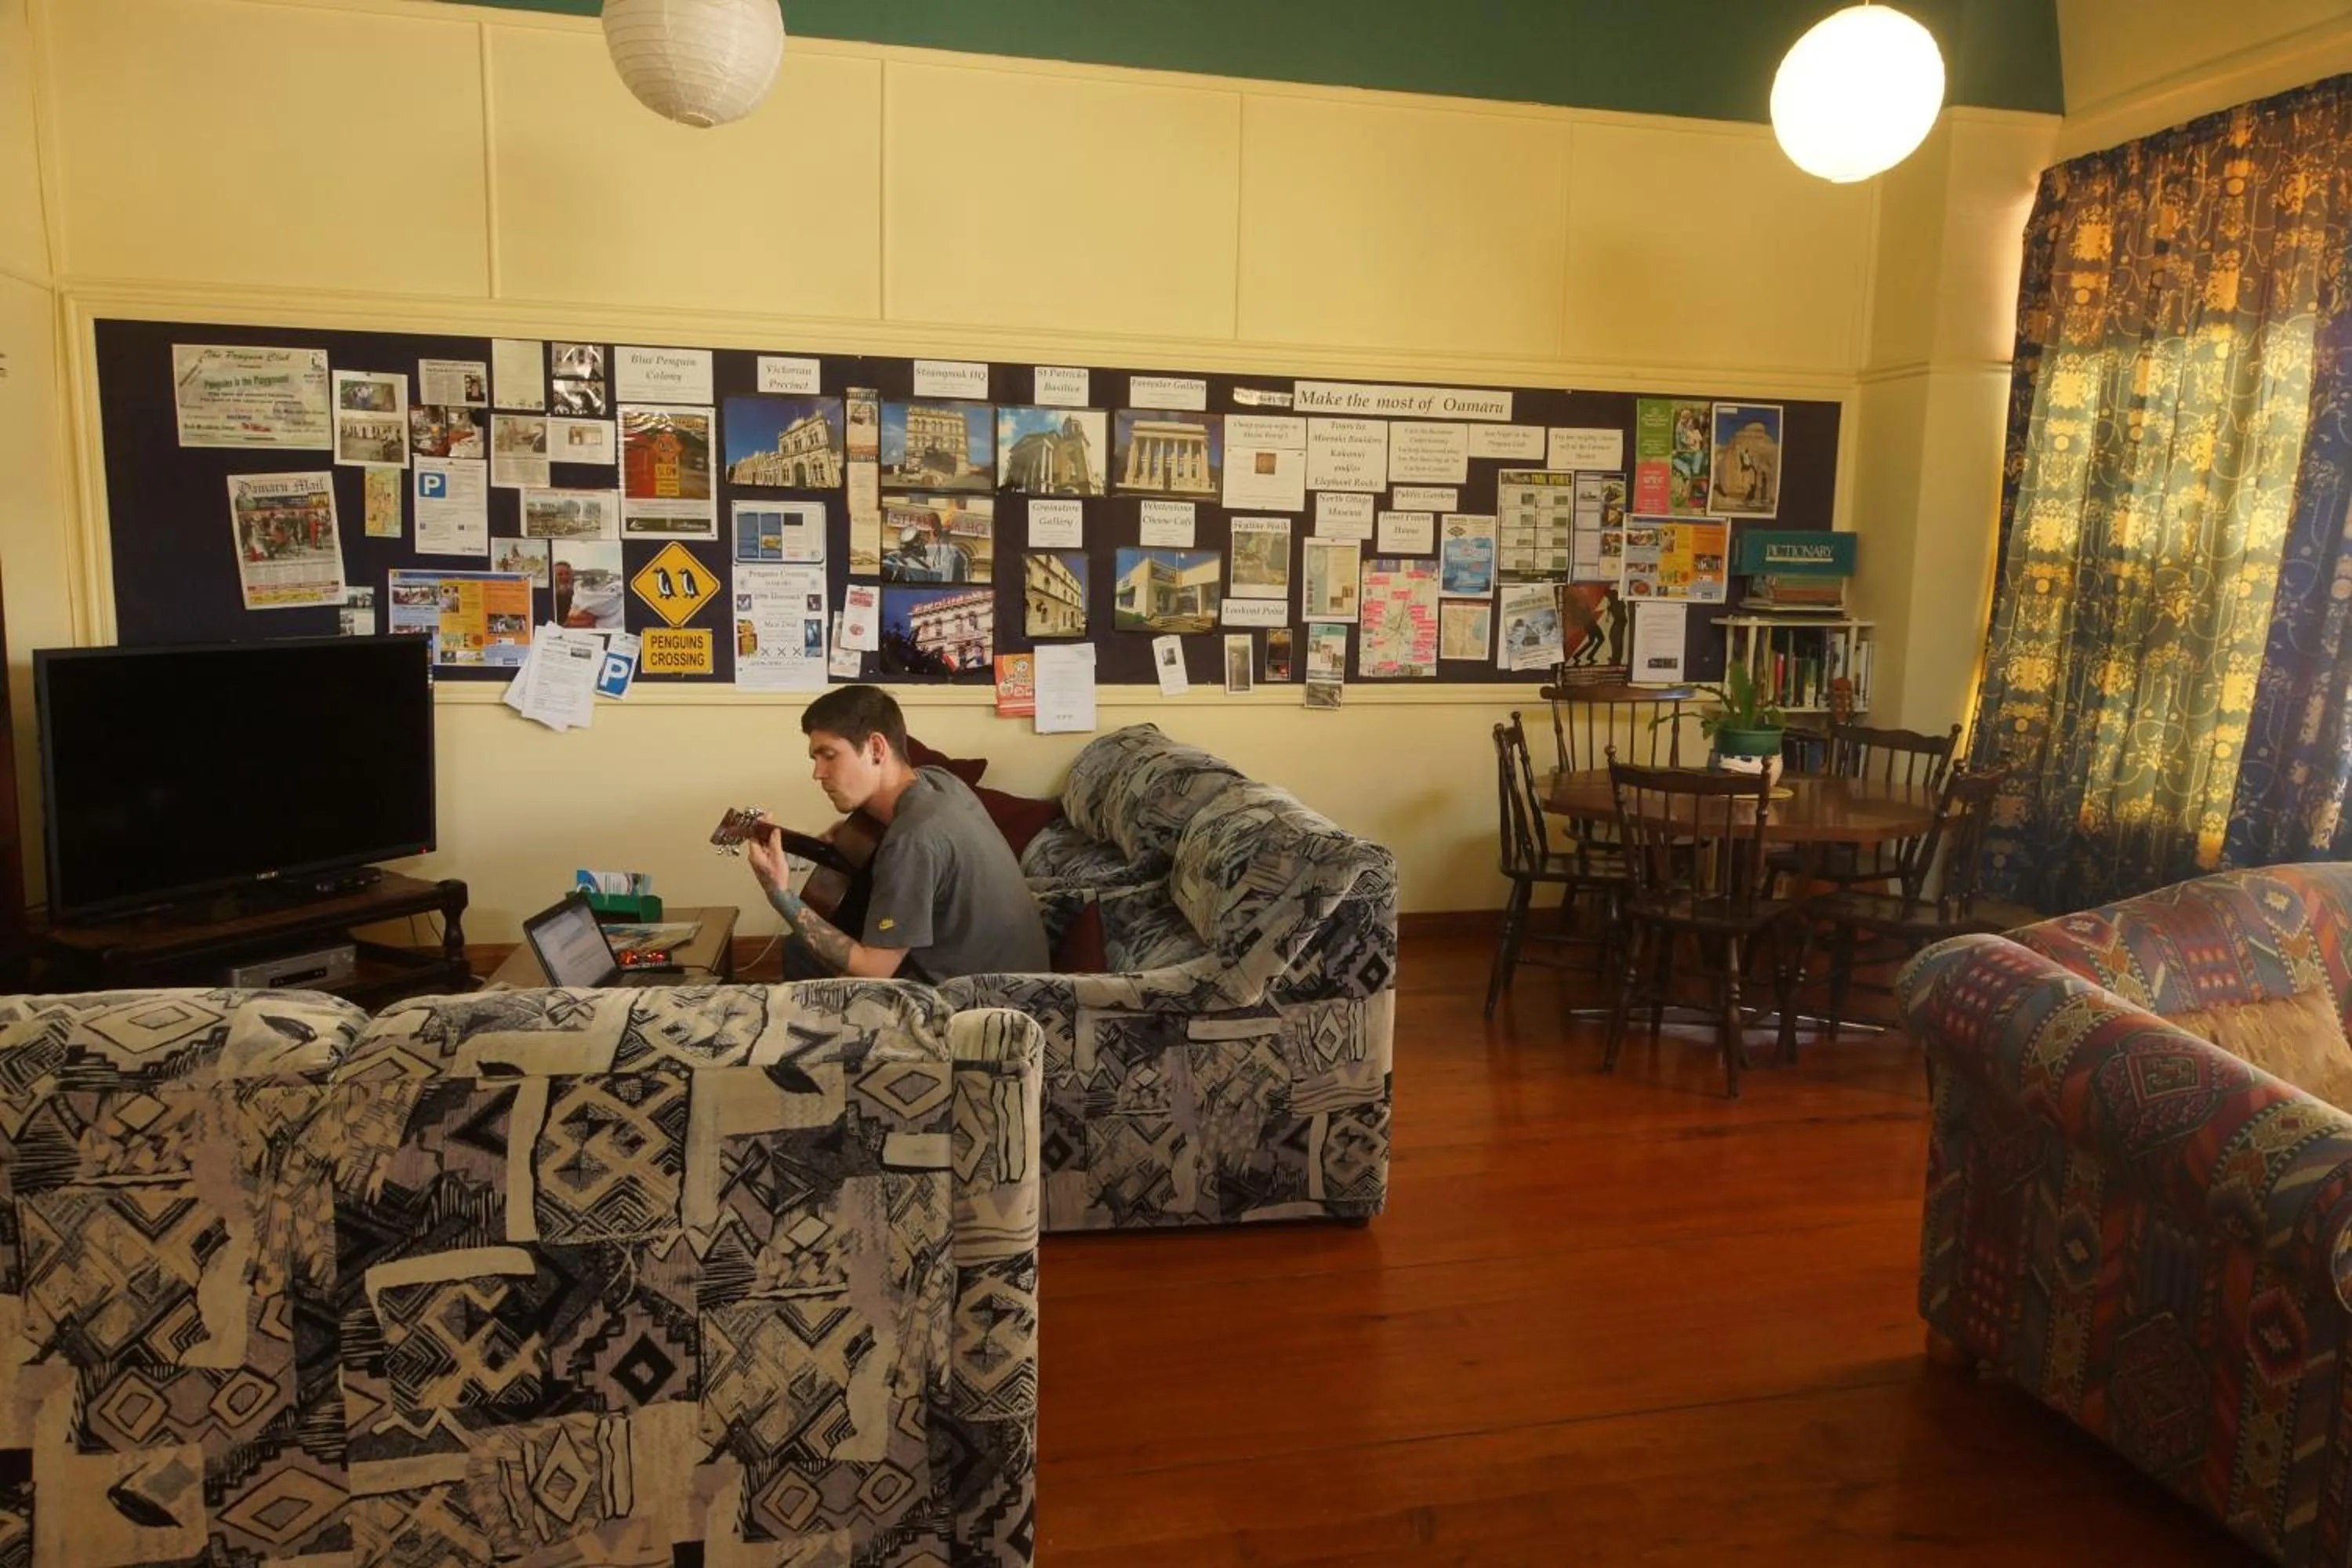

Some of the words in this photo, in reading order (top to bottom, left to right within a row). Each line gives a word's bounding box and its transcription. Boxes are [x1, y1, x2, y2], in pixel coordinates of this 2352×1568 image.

[631, 354, 652, 365] Blue
[656, 355, 696, 367] Penguin
[645, 370, 681, 382] Colony
[766, 364, 812, 376] Victorian
[768, 378, 809, 390] Precinct
[1174, 381, 1205, 392] Gallery
[1299, 390, 1342, 406] Make
[1346, 391, 1370, 408] the
[1376, 396, 1414, 410] most
[1417, 396, 1435, 415] of
[1443, 397, 1504, 414] Oamaru
[424, 475, 441, 495] P
[1319, 494, 1343, 503] North
[1395, 489, 1421, 499] Public
[1038, 517, 1073, 528] Gallery
[1766, 544, 1835, 557] PICTIONARY
[651, 635, 704, 650] PENGUINS
[650, 652, 706, 666] CROSSING
[600, 657, 630, 688] P
